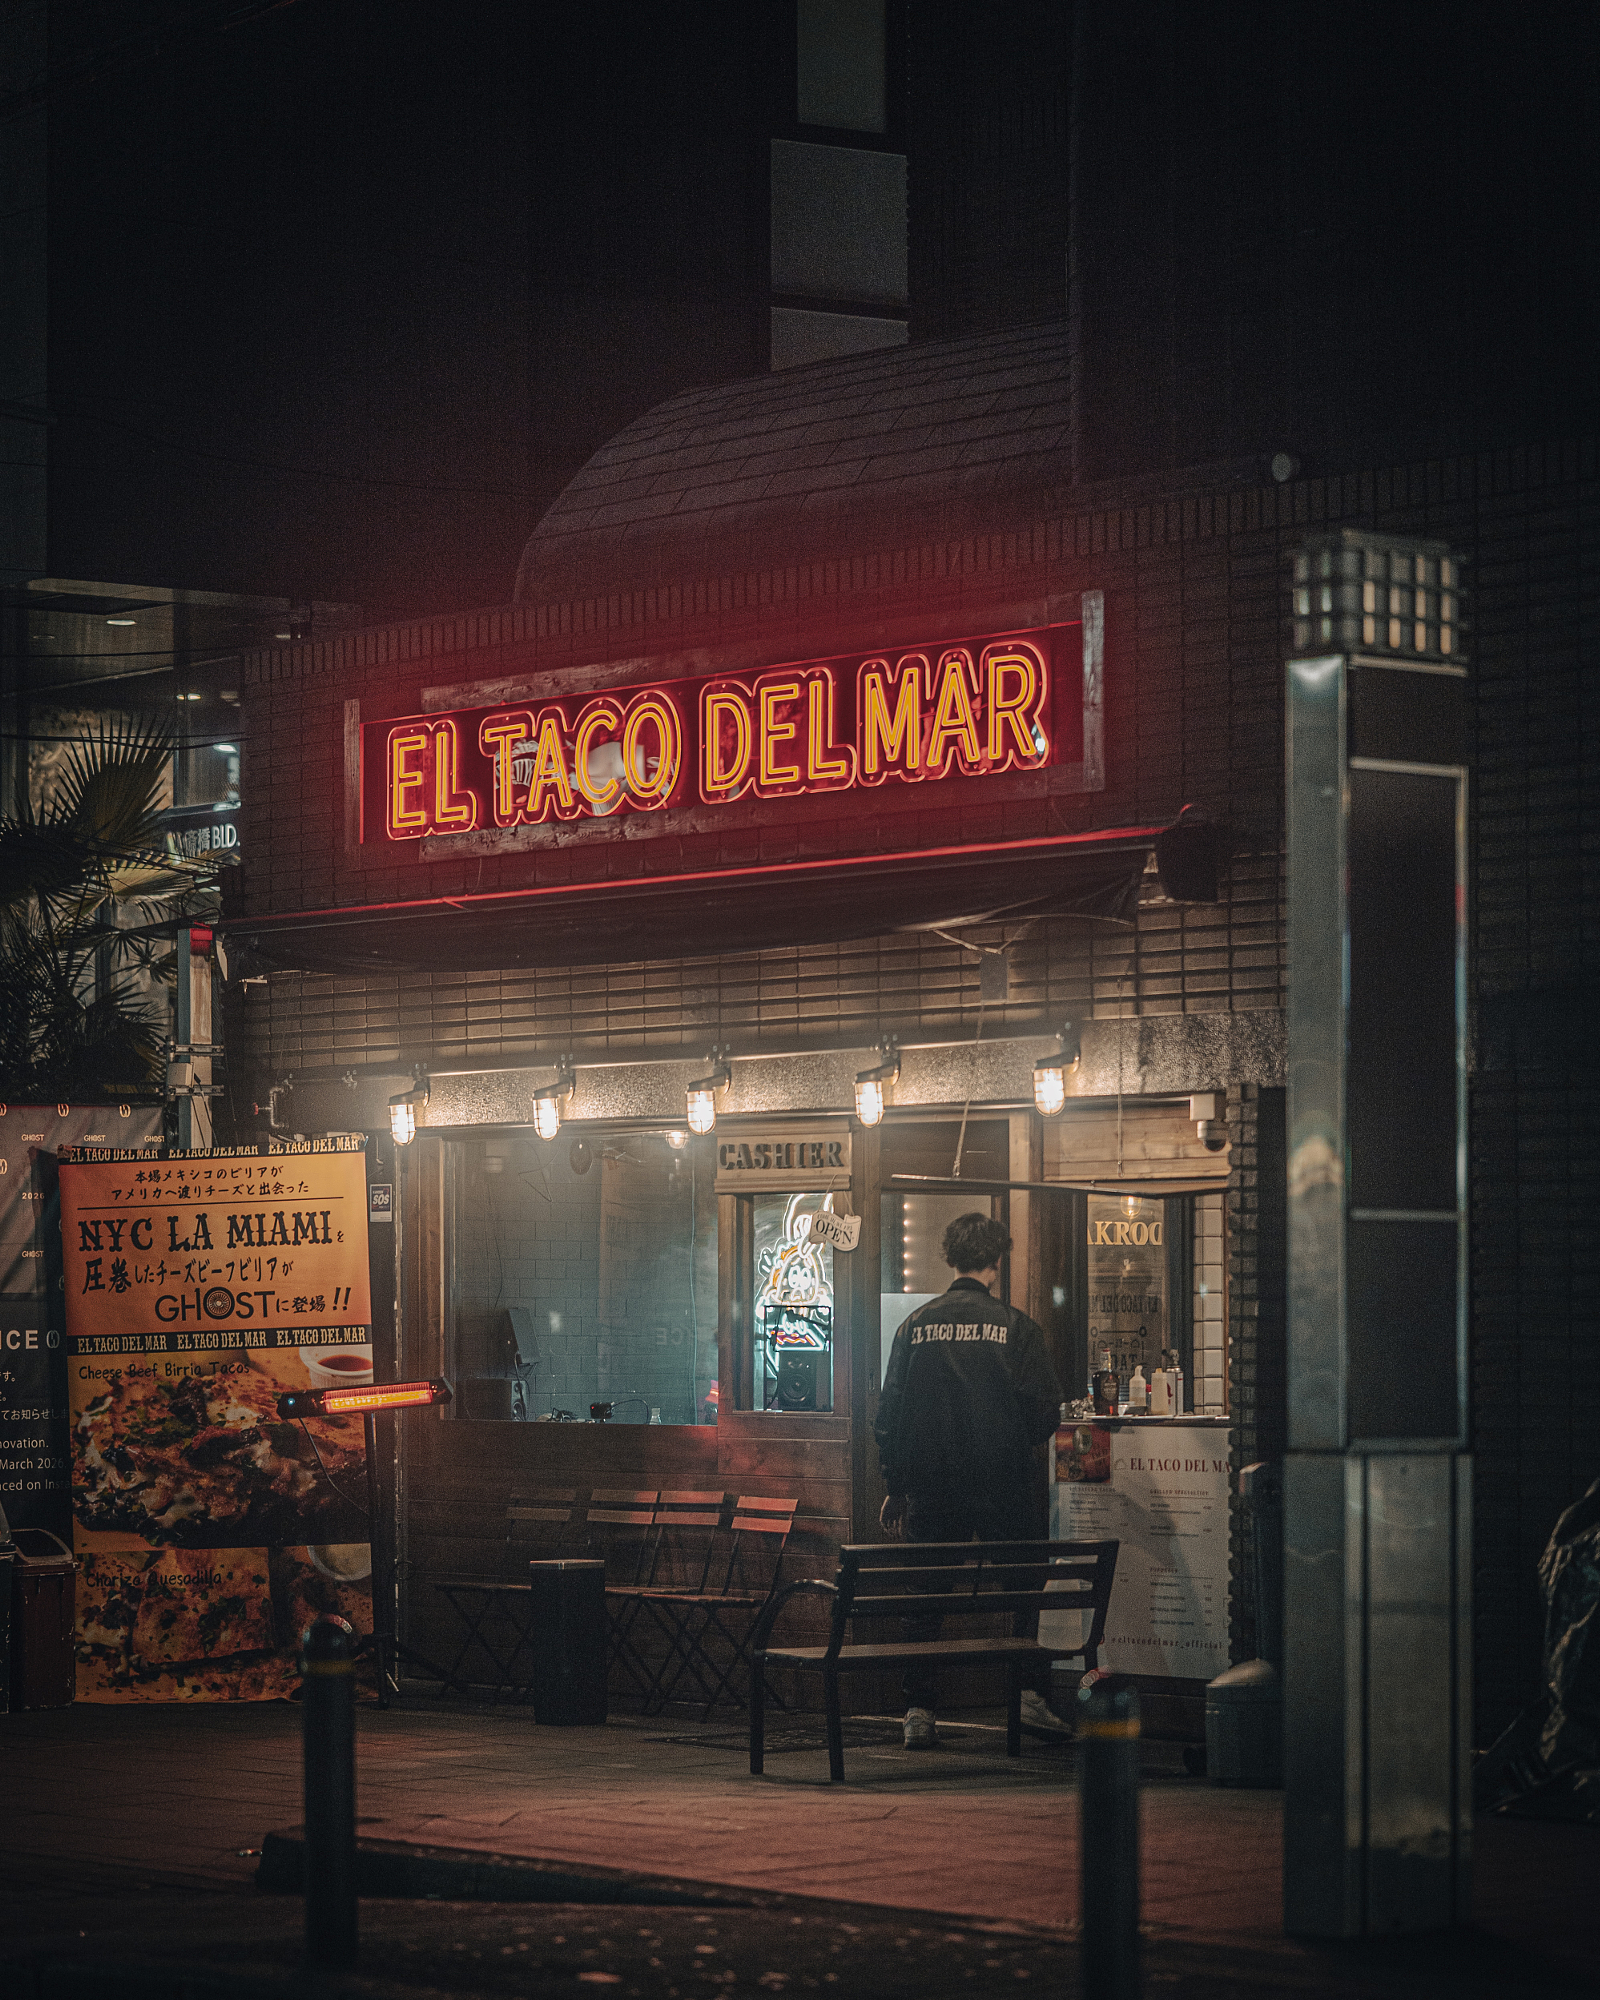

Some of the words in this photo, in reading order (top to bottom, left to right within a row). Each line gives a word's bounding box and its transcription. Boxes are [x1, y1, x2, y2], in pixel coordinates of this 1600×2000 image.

[388, 721, 474, 839] EL
[482, 693, 680, 823] TACO
[700, 669, 854, 801] DEL
[859, 645, 1046, 784] MAR
[211, 823, 241, 849] BLD.
[22, 1134, 45, 1142] GHOST
[84, 1134, 106, 1142] GHOST
[268, 1143, 284, 1155] EL
[285, 1141, 311, 1154] TACO
[313, 1138, 335, 1153] DEL
[336, 1136, 359, 1151] MAR
[69, 1147, 82, 1162] EL
[85, 1148, 111, 1161] TACO
[113, 1148, 135, 1160] DEL
[136, 1148, 158, 1160] MAR
[717, 1141, 844, 1170] CASHIER
[135, 1165, 284, 1184] 本場メキシコのビリアが
[22, 1192, 45, 1200] 2026
[111, 1180, 309, 1200] アメリカへ渡りチーズと出会った
[372, 1194, 390, 1205] SOS
[77, 1217, 153, 1252] NYC
[167, 1212, 214, 1252] LA
[227, 1210, 333, 1248] MIAMI
[815, 1219, 853, 1245] OPEN
[22, 1250, 44, 1258] GHOST
[82, 1256, 294, 1294] 圧巻したチーズビーフビリアが
[155, 1286, 275, 1322] GHOST
[0, 1330, 39, 1350] CE
[177, 1334, 192, 1350] EL
[193, 1333, 219, 1349] TACO
[221, 1332, 243, 1348] DEL
[244, 1331, 267, 1347] MAR
[276, 1330, 292, 1346] EL
[292, 1329, 319, 1345] TACO
[320, 1328, 343, 1344] DEL
[343, 1327, 366, 1343] MAR
[925, 1324, 954, 1341] TACO
[955, 1324, 981, 1341] DEL
[982, 1324, 1008, 1344] MAR
[78, 1338, 92, 1353] EL
[93, 1337, 120, 1352] TACO
[122, 1336, 144, 1351] DEL
[145, 1335, 167, 1350] MAR
[0, 1370, 16, 1383] す。
[79, 1366, 122, 1379] Cheese
[129, 1362, 158, 1377] Beef
[165, 1362, 202, 1376] Birria
[209, 1361, 250, 1374] Tacos
[1130, 1457, 1145, 1471] EL
[1147, 1458, 1181, 1472] TACO
[1185, 1459, 1209, 1473] DEL
[27, 1481, 41, 1490] on
